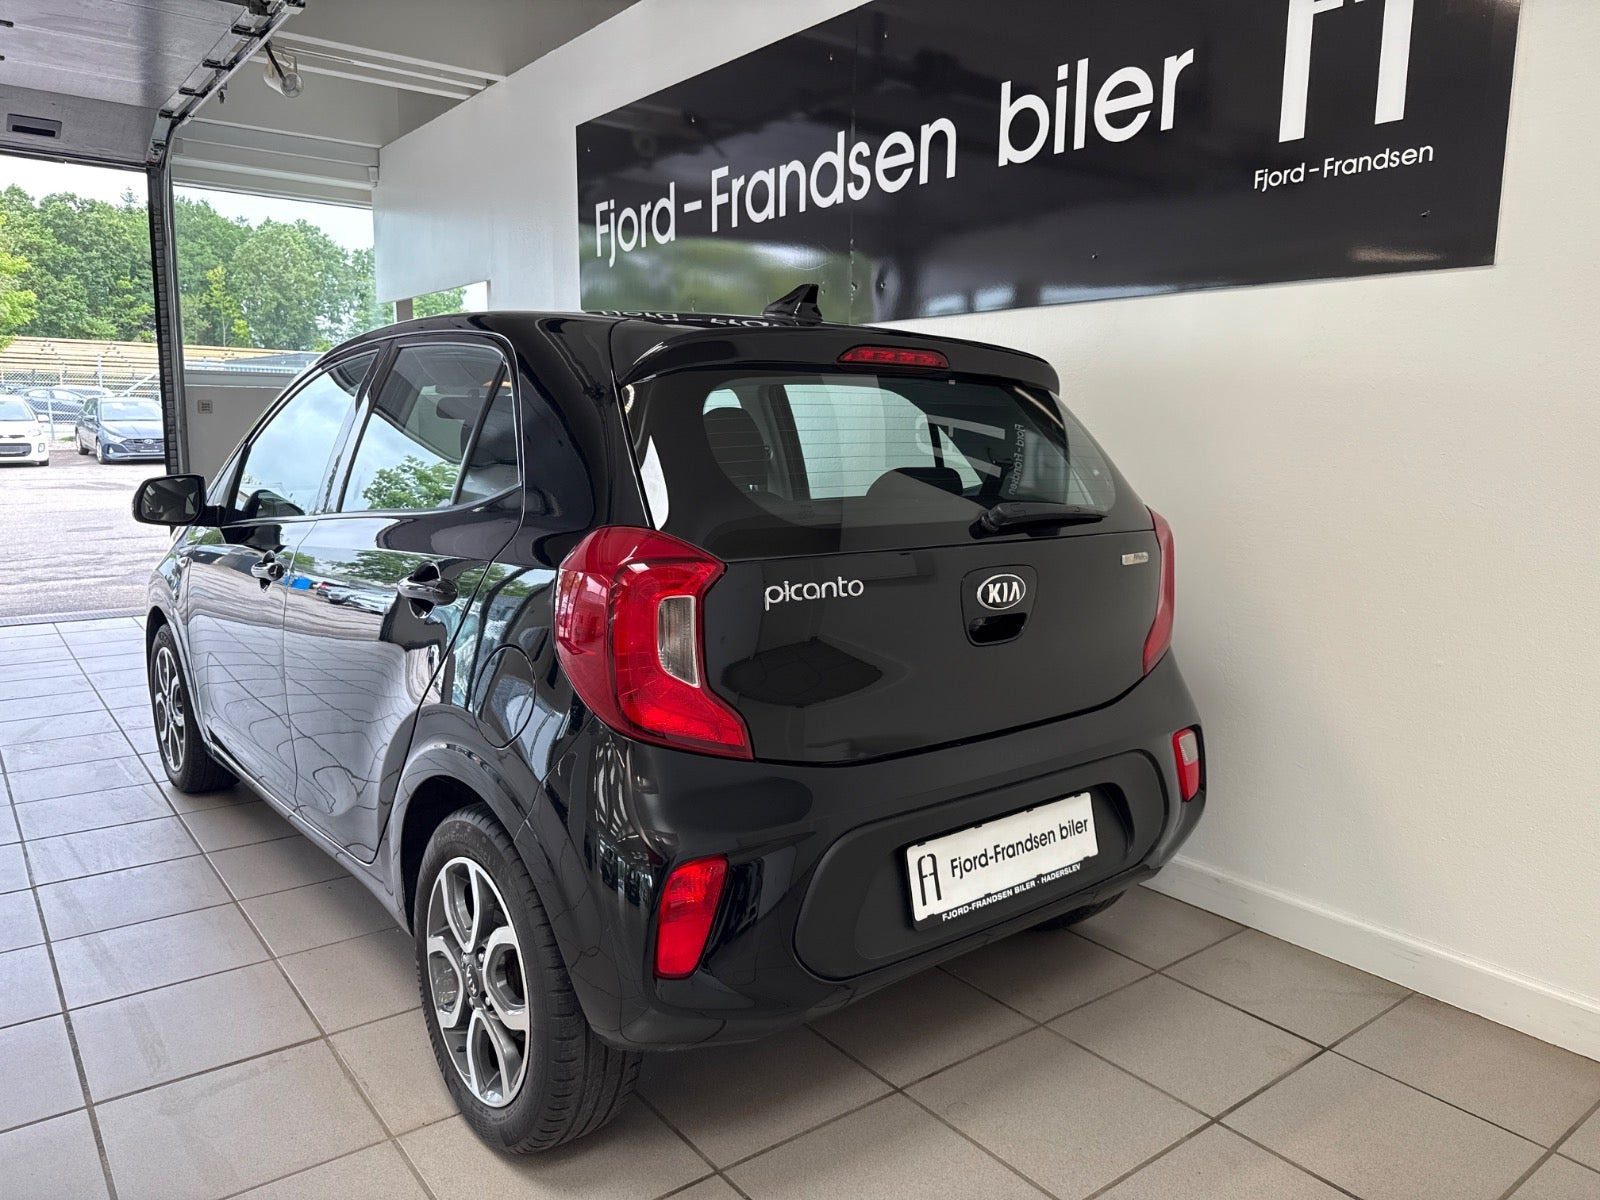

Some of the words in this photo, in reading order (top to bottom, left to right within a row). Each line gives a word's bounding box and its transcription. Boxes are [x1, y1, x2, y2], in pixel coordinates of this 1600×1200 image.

[998, 48, 1194, 167] biler
[764, 575, 865, 612] picanto
[987, 581, 1021, 604] KIA
[950, 830, 1056, 880] Fjord-Frandsen
[1058, 818, 1089, 840] biler
[941, 888, 1014, 922] FJORD-FRANDSEN
[1013, 880, 1036, 894] BILER
[1040, 862, 1081, 884] HADERSLEV
